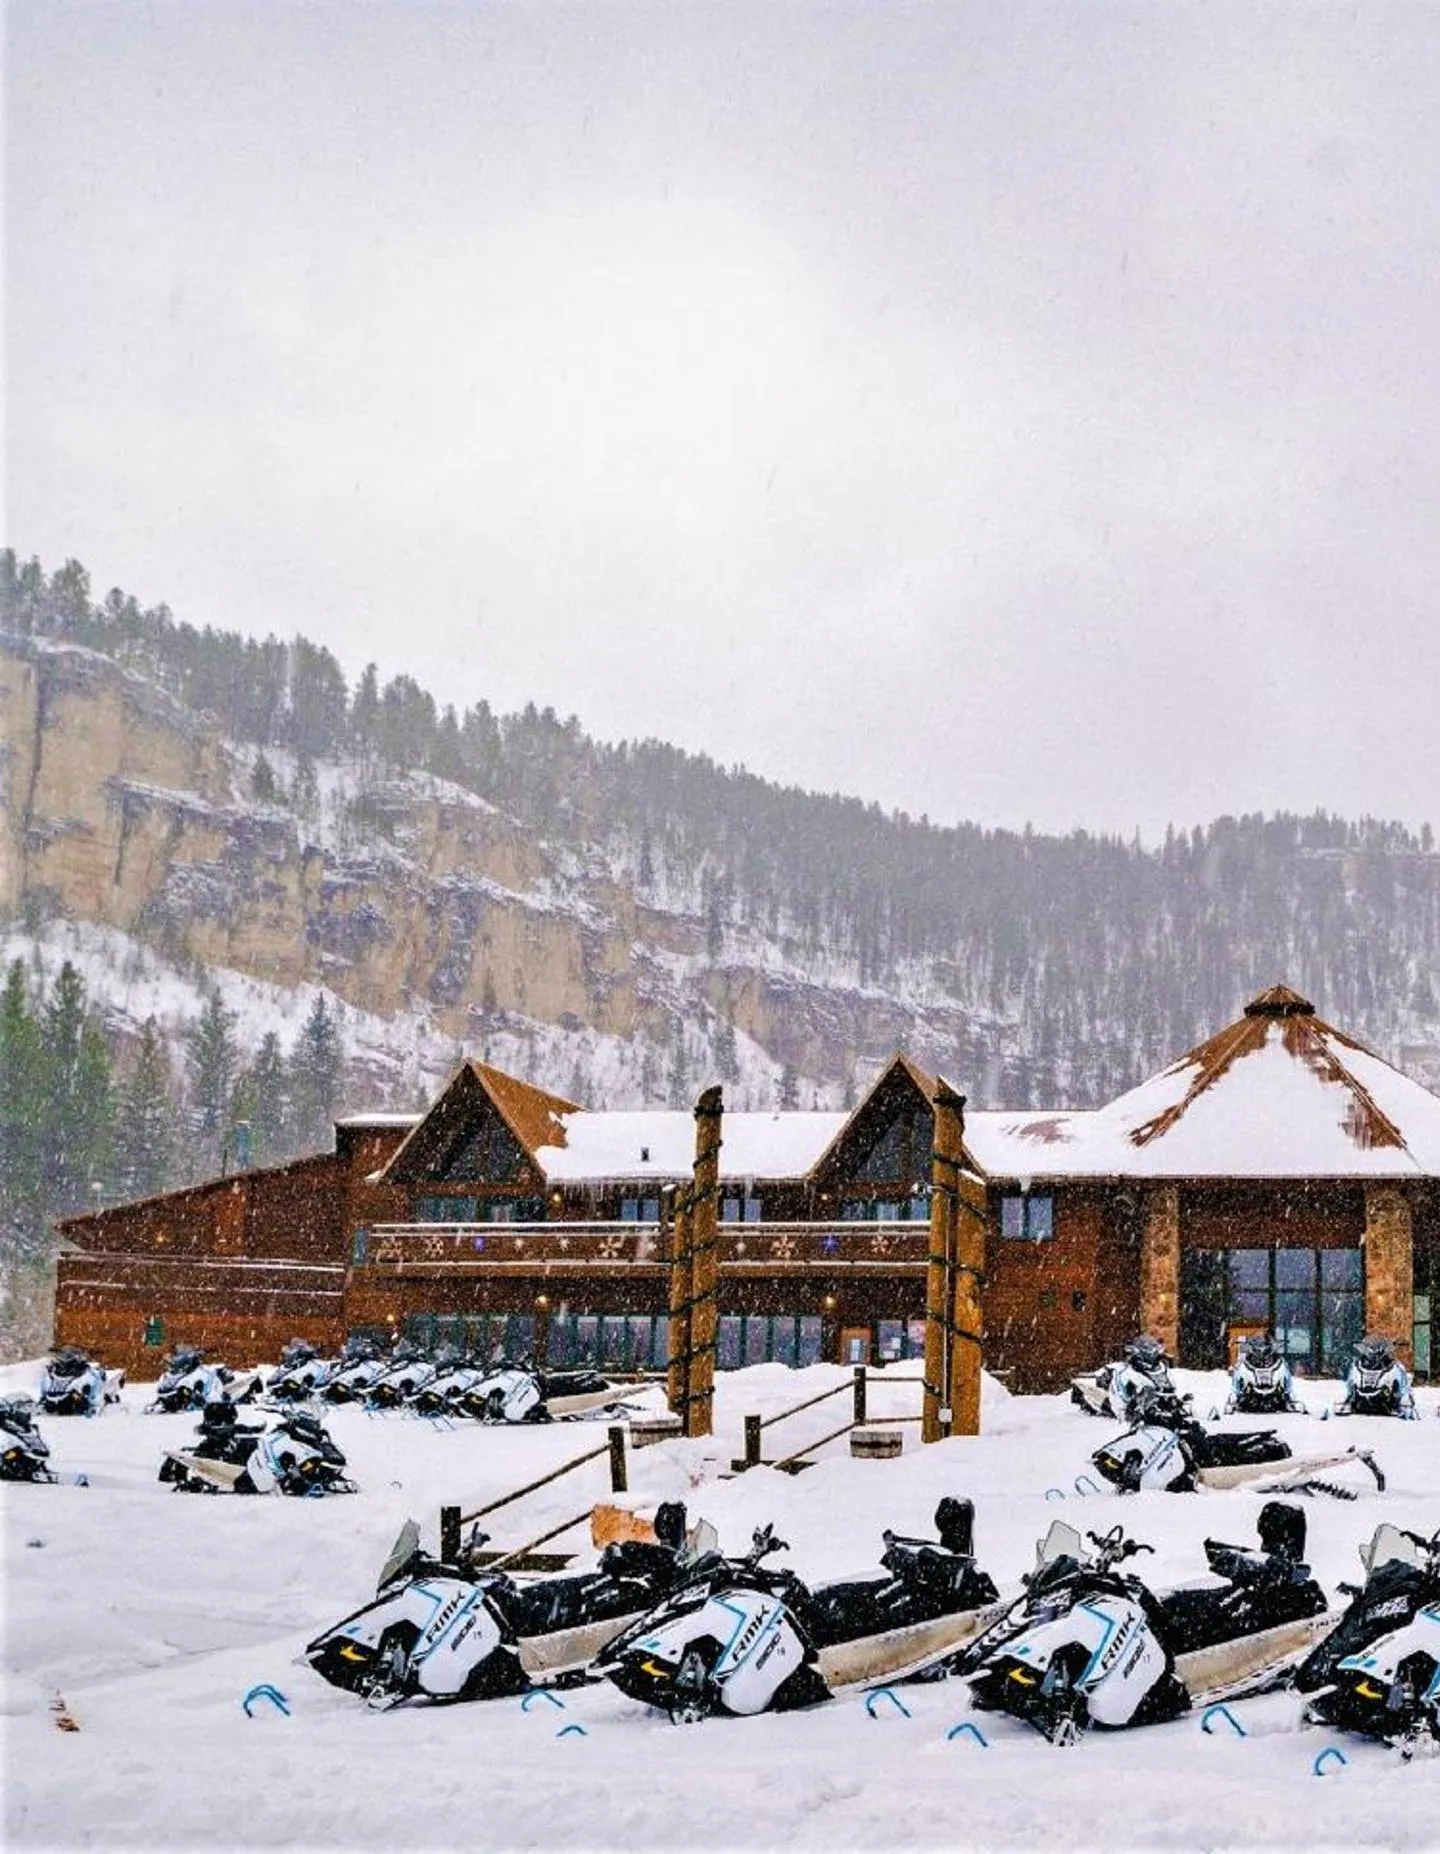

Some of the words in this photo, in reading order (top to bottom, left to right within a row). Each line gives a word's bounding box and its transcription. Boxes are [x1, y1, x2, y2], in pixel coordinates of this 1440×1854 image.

[426, 1589, 465, 1643] RMK
[732, 1604, 770, 1662] RMK
[1101, 1611, 1135, 1671] RMK
